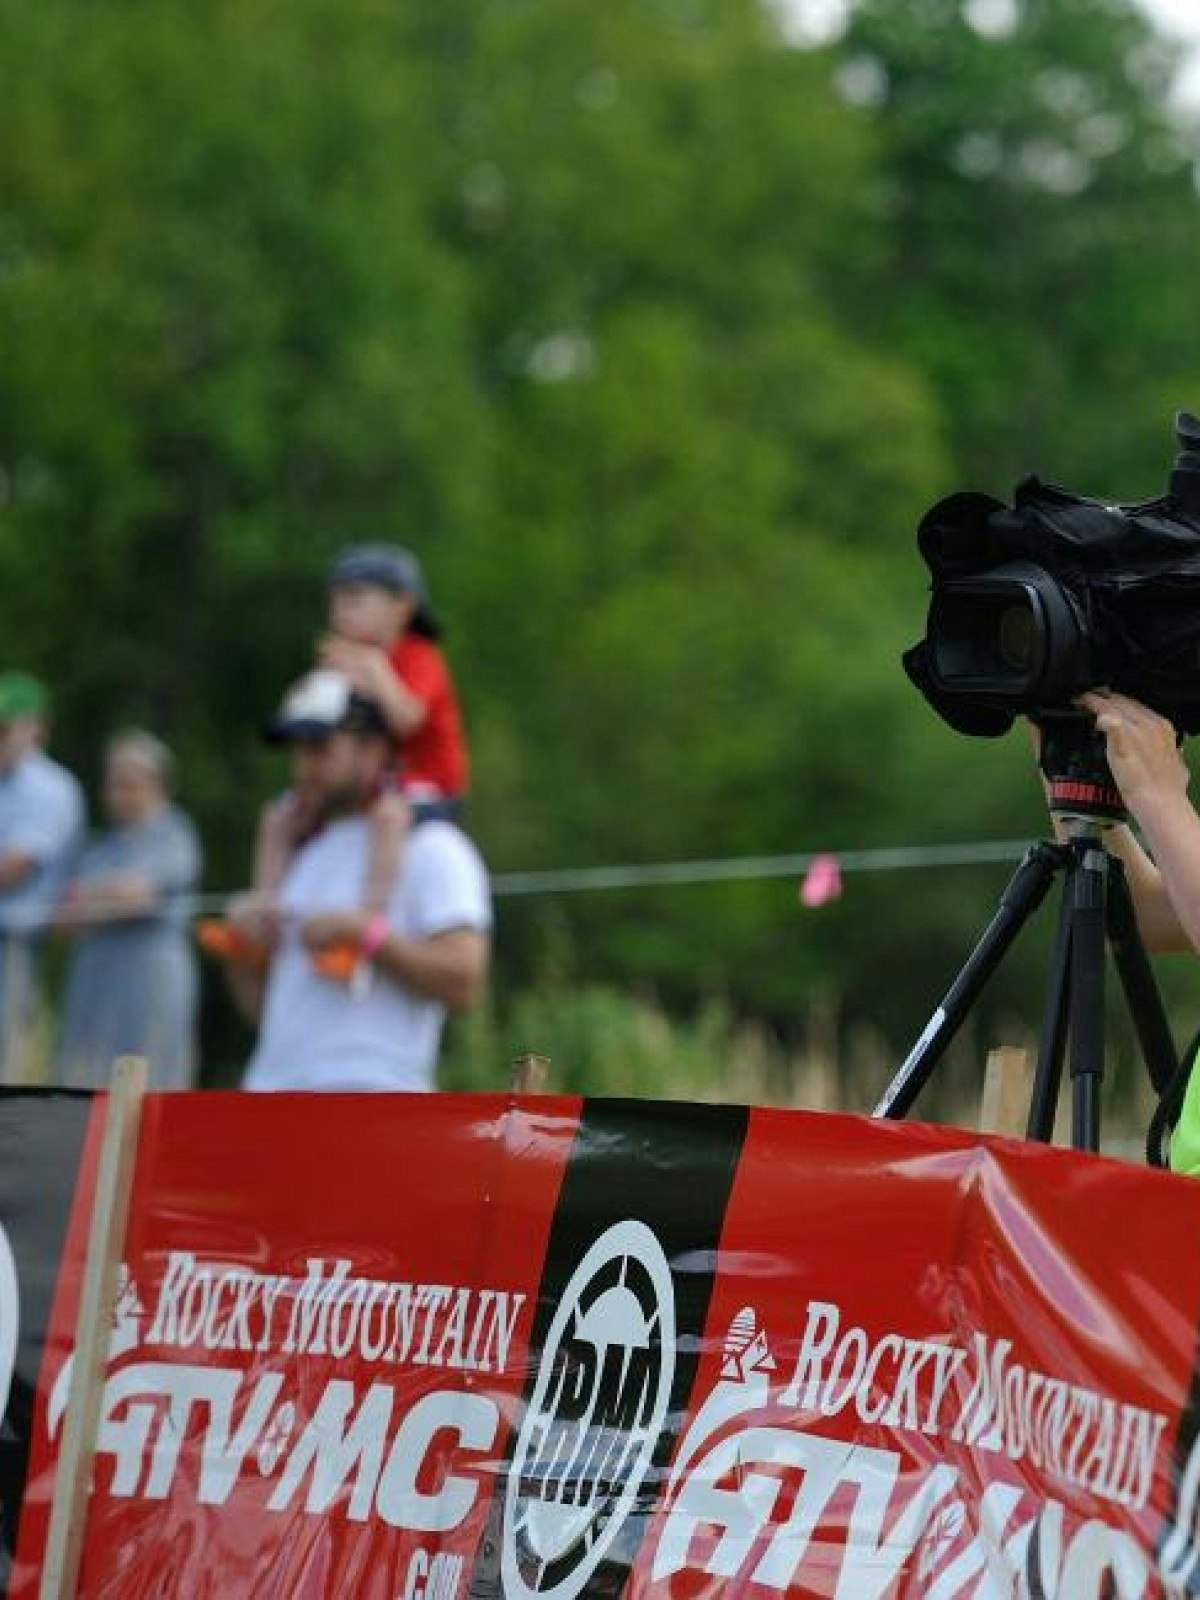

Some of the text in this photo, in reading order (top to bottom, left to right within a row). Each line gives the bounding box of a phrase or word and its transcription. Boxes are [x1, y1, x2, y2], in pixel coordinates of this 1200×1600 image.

[144, 1250, 527, 1373] ROCKY MOUNTAIN
[780, 1300, 1169, 1510] ROCKY MOUNTAIN
